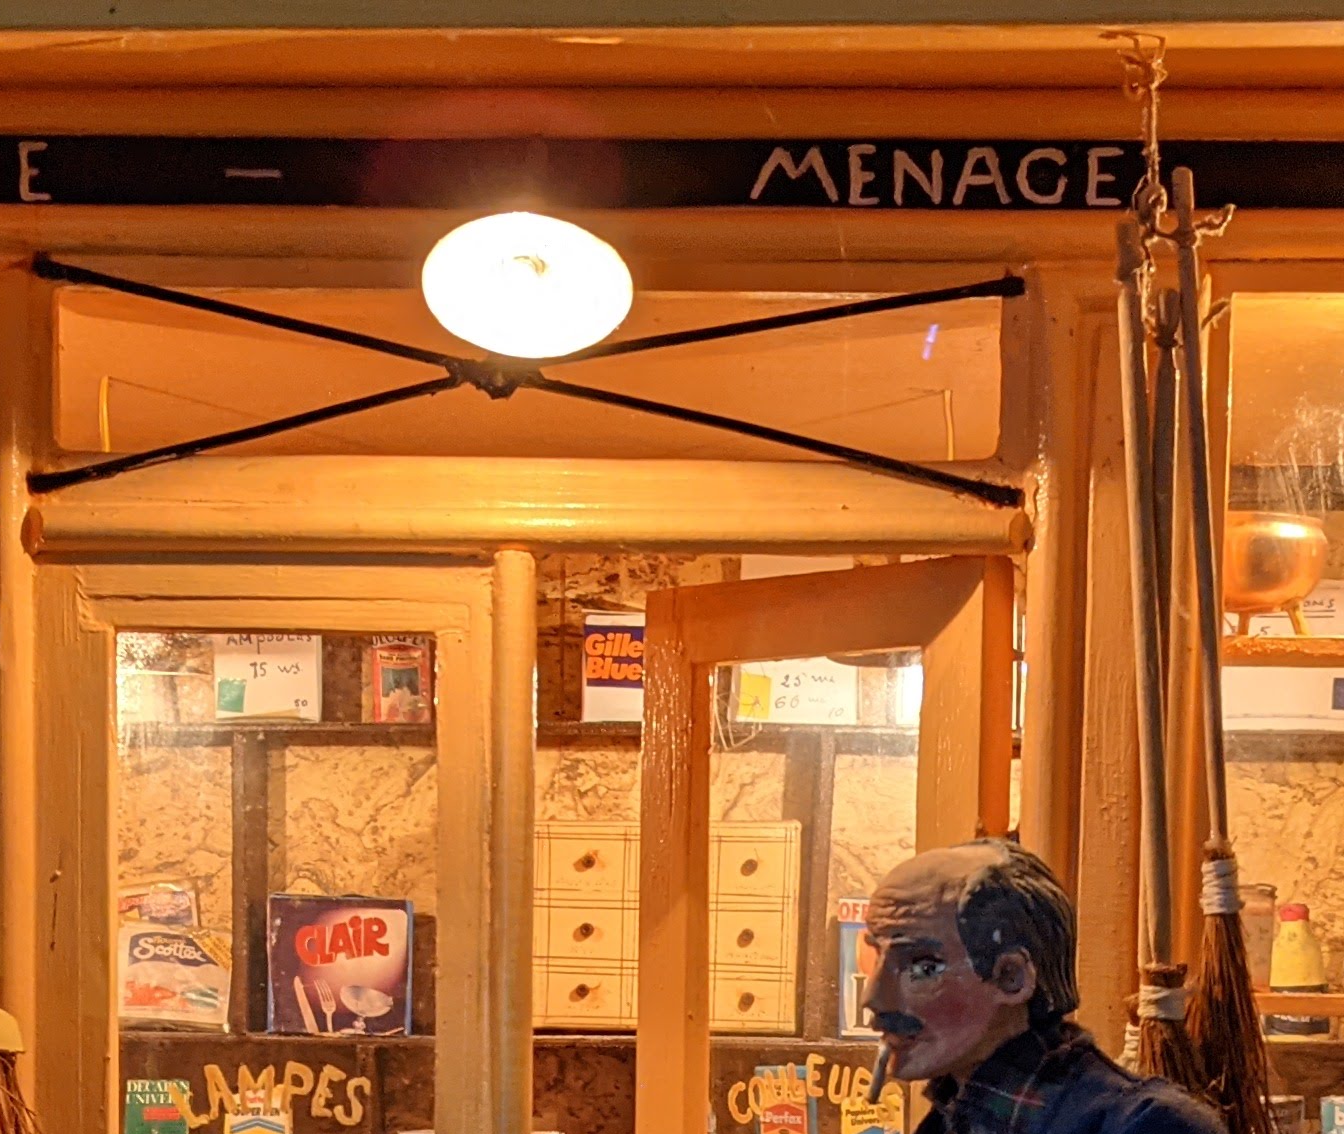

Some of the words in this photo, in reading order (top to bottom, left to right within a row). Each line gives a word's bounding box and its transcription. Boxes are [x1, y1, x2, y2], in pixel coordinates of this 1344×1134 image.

[586, 656, 643, 680] Blue
[133, 937, 206, 963] Scottex
[171, 1061, 370, 1128] LAMPES
[760, 1110, 803, 1124] Perfax
